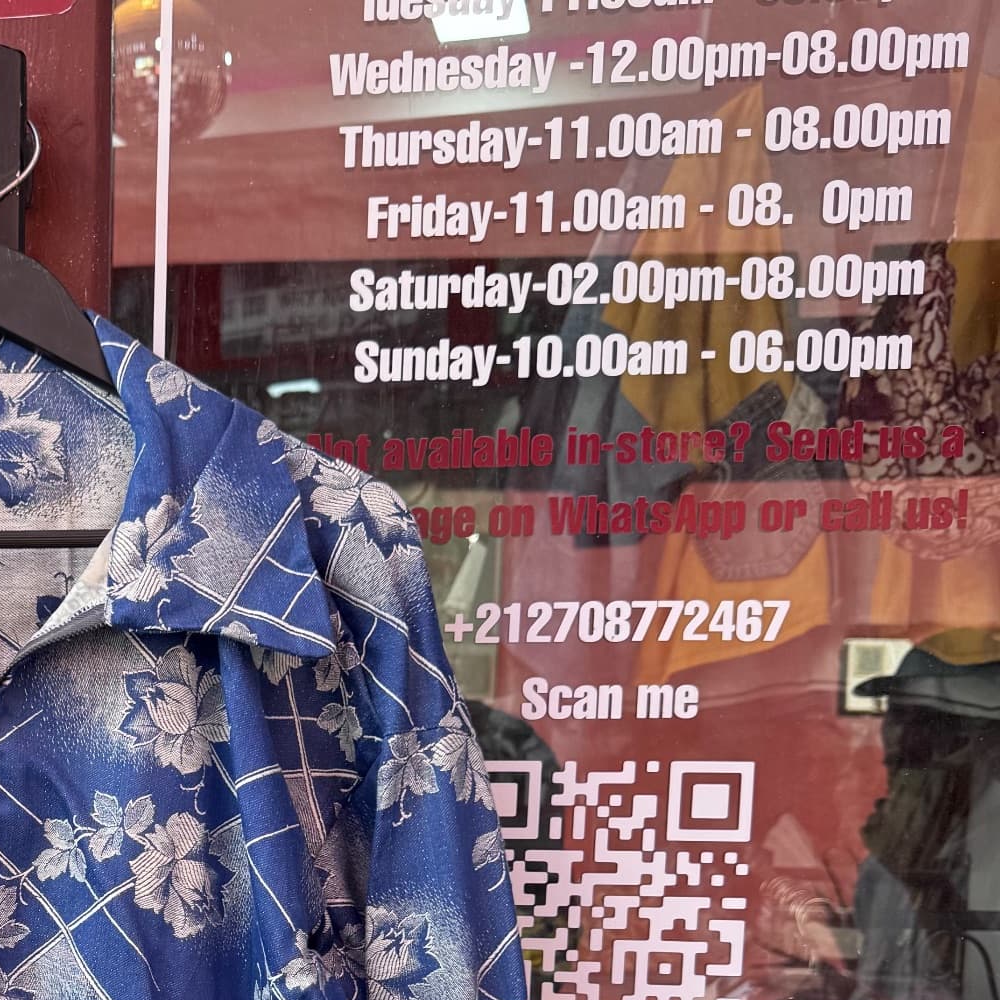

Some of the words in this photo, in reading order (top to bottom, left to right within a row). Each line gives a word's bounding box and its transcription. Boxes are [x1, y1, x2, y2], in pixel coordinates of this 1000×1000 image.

[329, 45, 557, 97] Wednesday
[569, 26, 970, 87] -12.00pm-08.00pm
[339, 112, 723, 169] Thursday-11.00am
[736, 127, 752, 138] -
[764, 102, 952, 154] 08.00pm
[366, 187, 687, 243] Friday-11.00am
[699, 203, 714, 213] -
[349, 253, 926, 314] Saturday-02.00pm-08.00pm
[353, 333, 688, 387] Sunday-10.00am
[700, 350, 716, 360] -
[729, 328, 914, 378] 06.00pm
[382, 427, 553, 471] available
[566, 421, 751, 466] in-store?
[765, 420, 865, 462] Send
[879, 425, 928, 459] us
[940, 424, 966, 459] a
[488, 503, 536, 538] on
[548, 494, 747, 540] WhatsApp
[760, 497, 808, 532] or
[821, 490, 893, 532] call
[905, 489, 970, 531] us!
[444, 600, 791, 644] +212708772467
[521, 676, 623, 720] Scan
[636, 683, 700, 720] me
